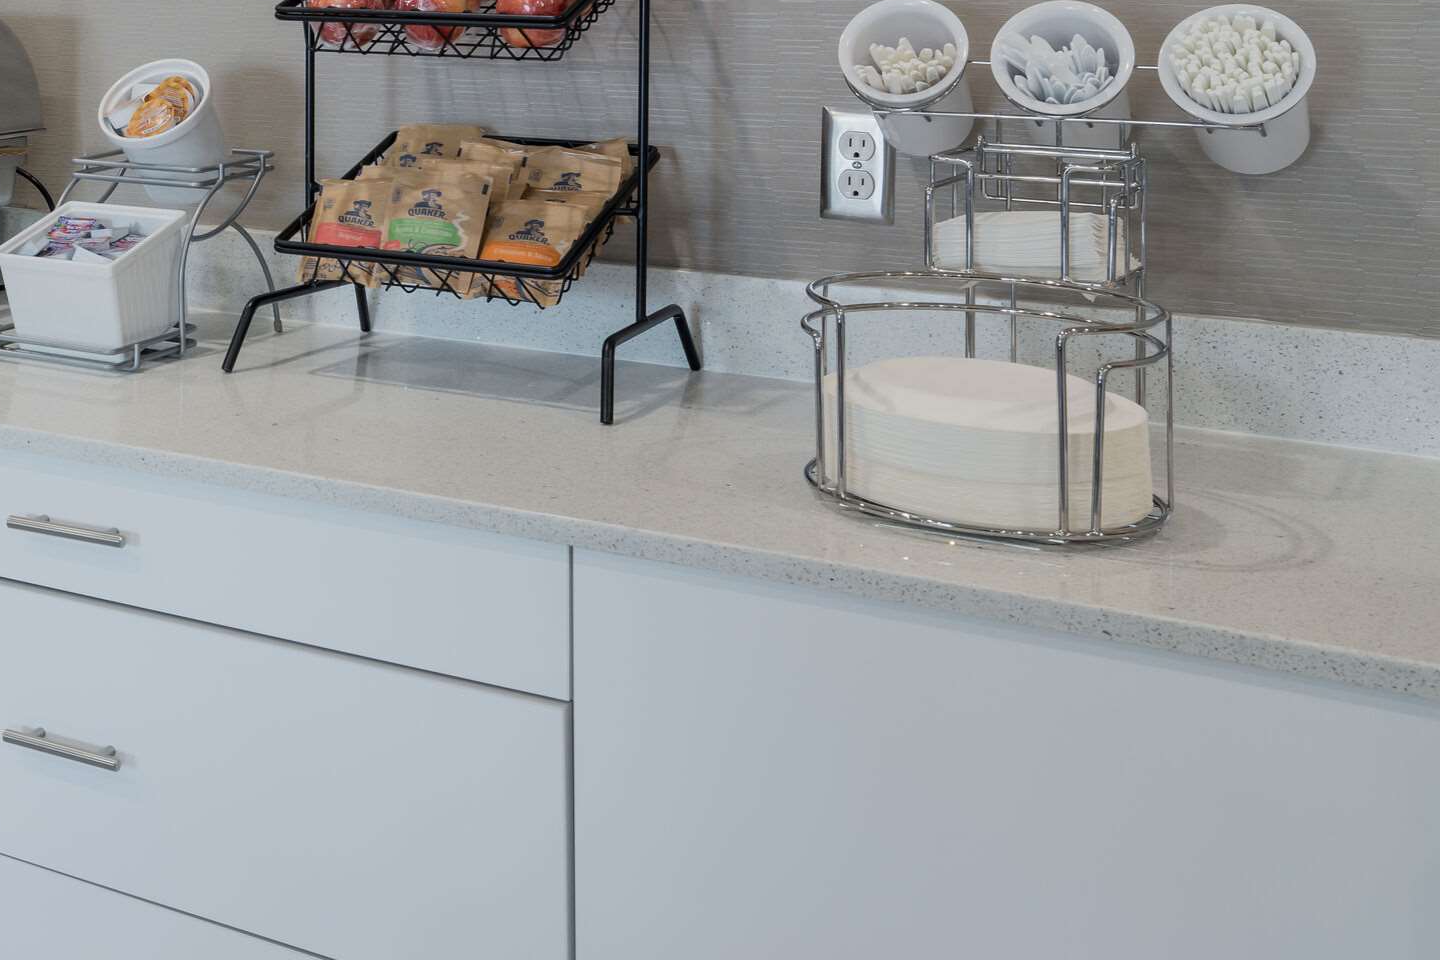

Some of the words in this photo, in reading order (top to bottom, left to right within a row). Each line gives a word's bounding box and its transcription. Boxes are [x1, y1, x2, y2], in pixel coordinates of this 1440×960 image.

[408, 207, 447, 219] QUAKER
[337, 214, 375, 227] QUAKER
[508, 233, 550, 246] QUAKER
